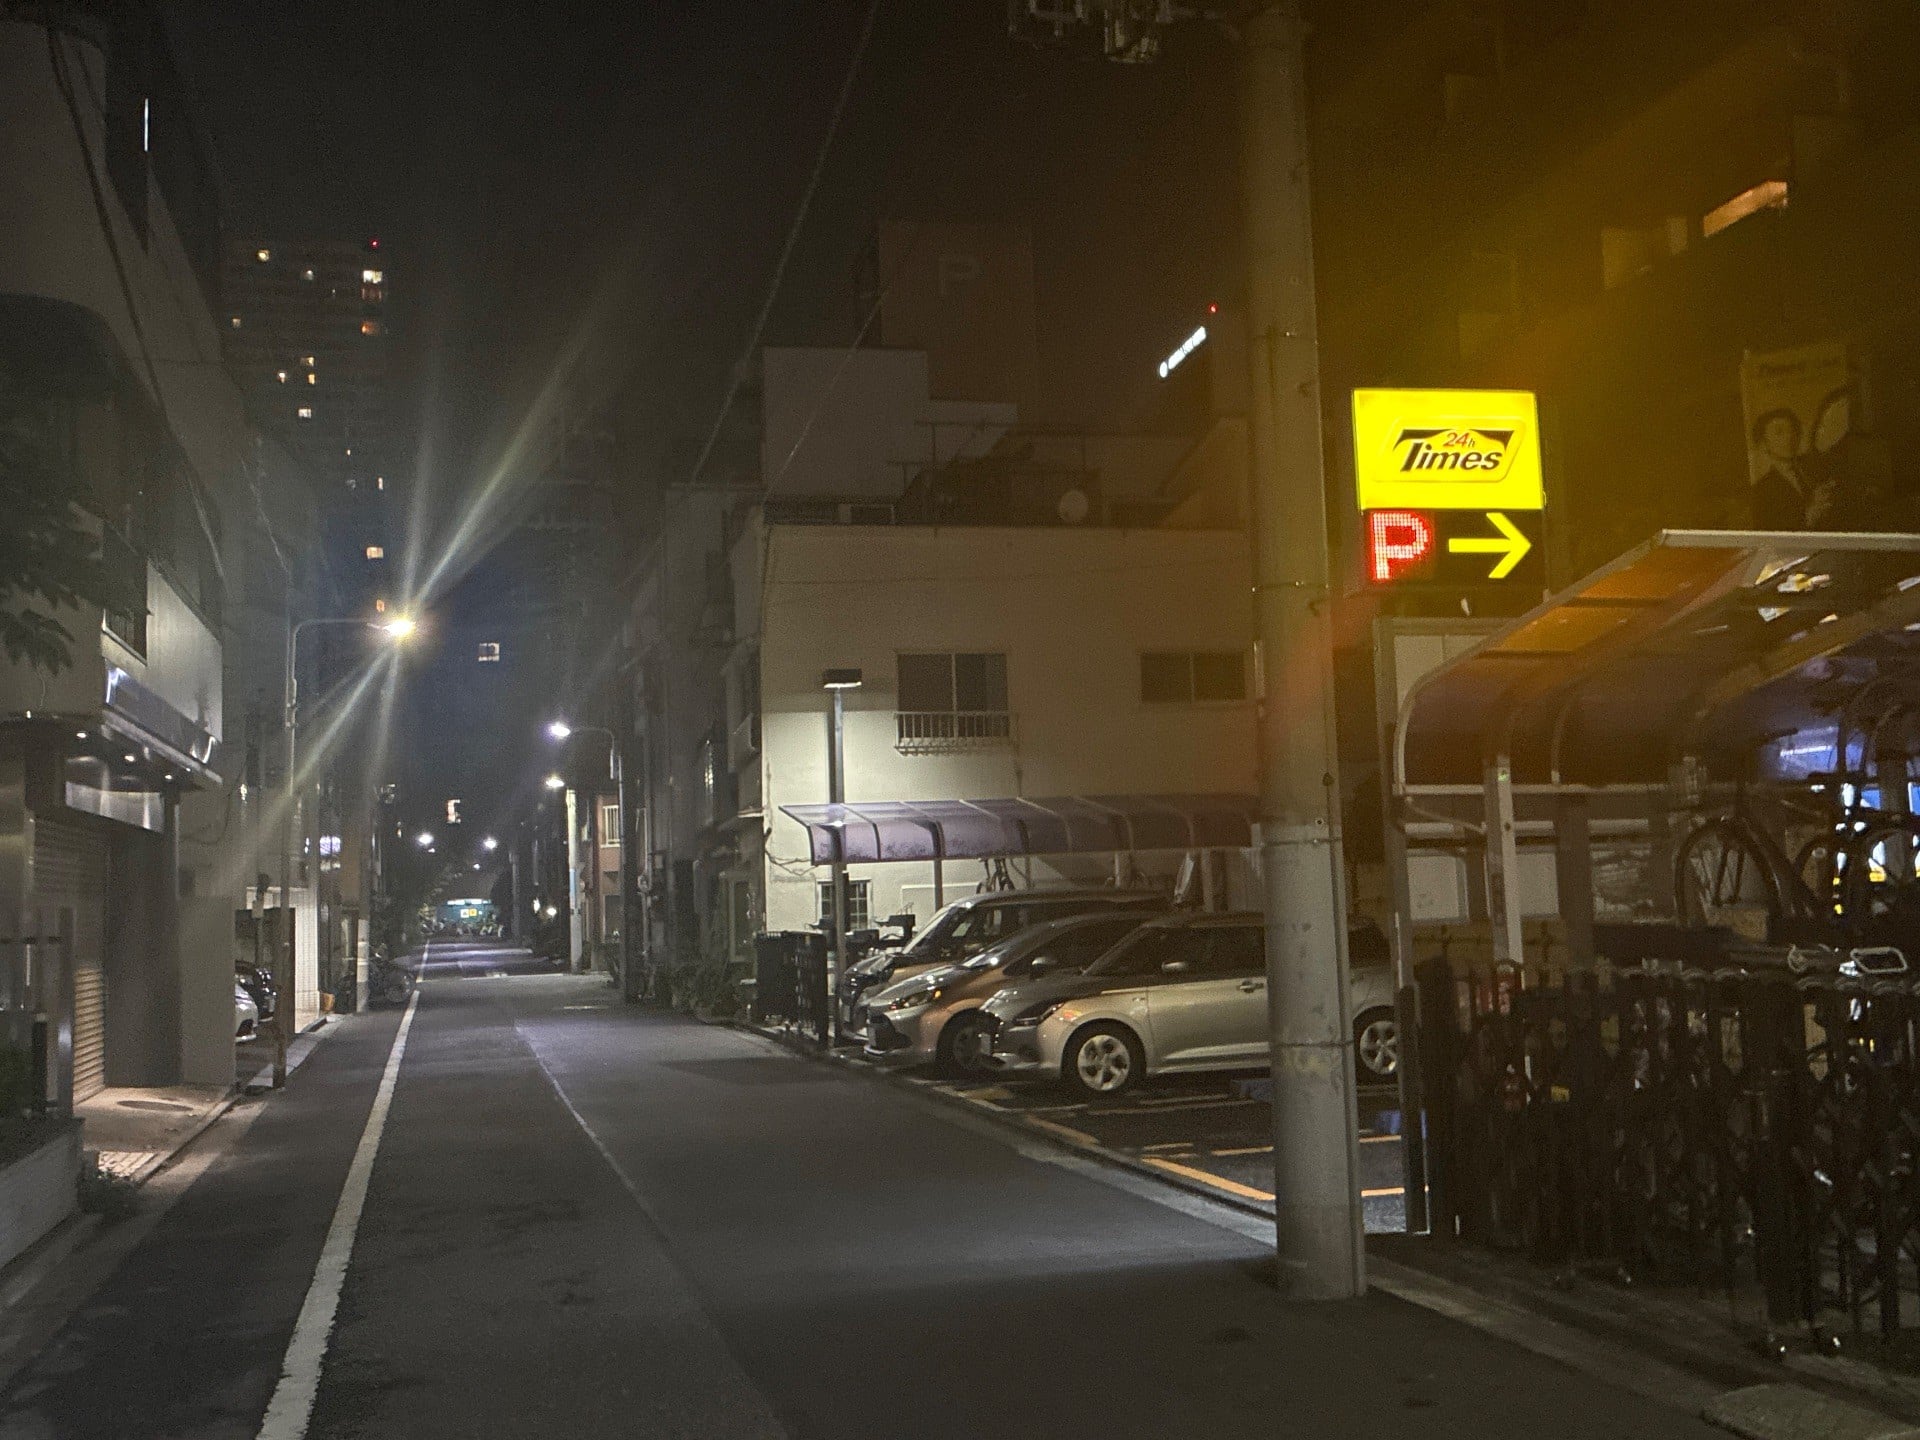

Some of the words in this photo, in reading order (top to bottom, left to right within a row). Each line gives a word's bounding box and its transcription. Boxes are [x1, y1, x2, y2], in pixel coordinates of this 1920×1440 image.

[1393, 430, 1503, 472] Times
[1443, 431, 1476, 448] 24h
[1373, 513, 1428, 579] P
